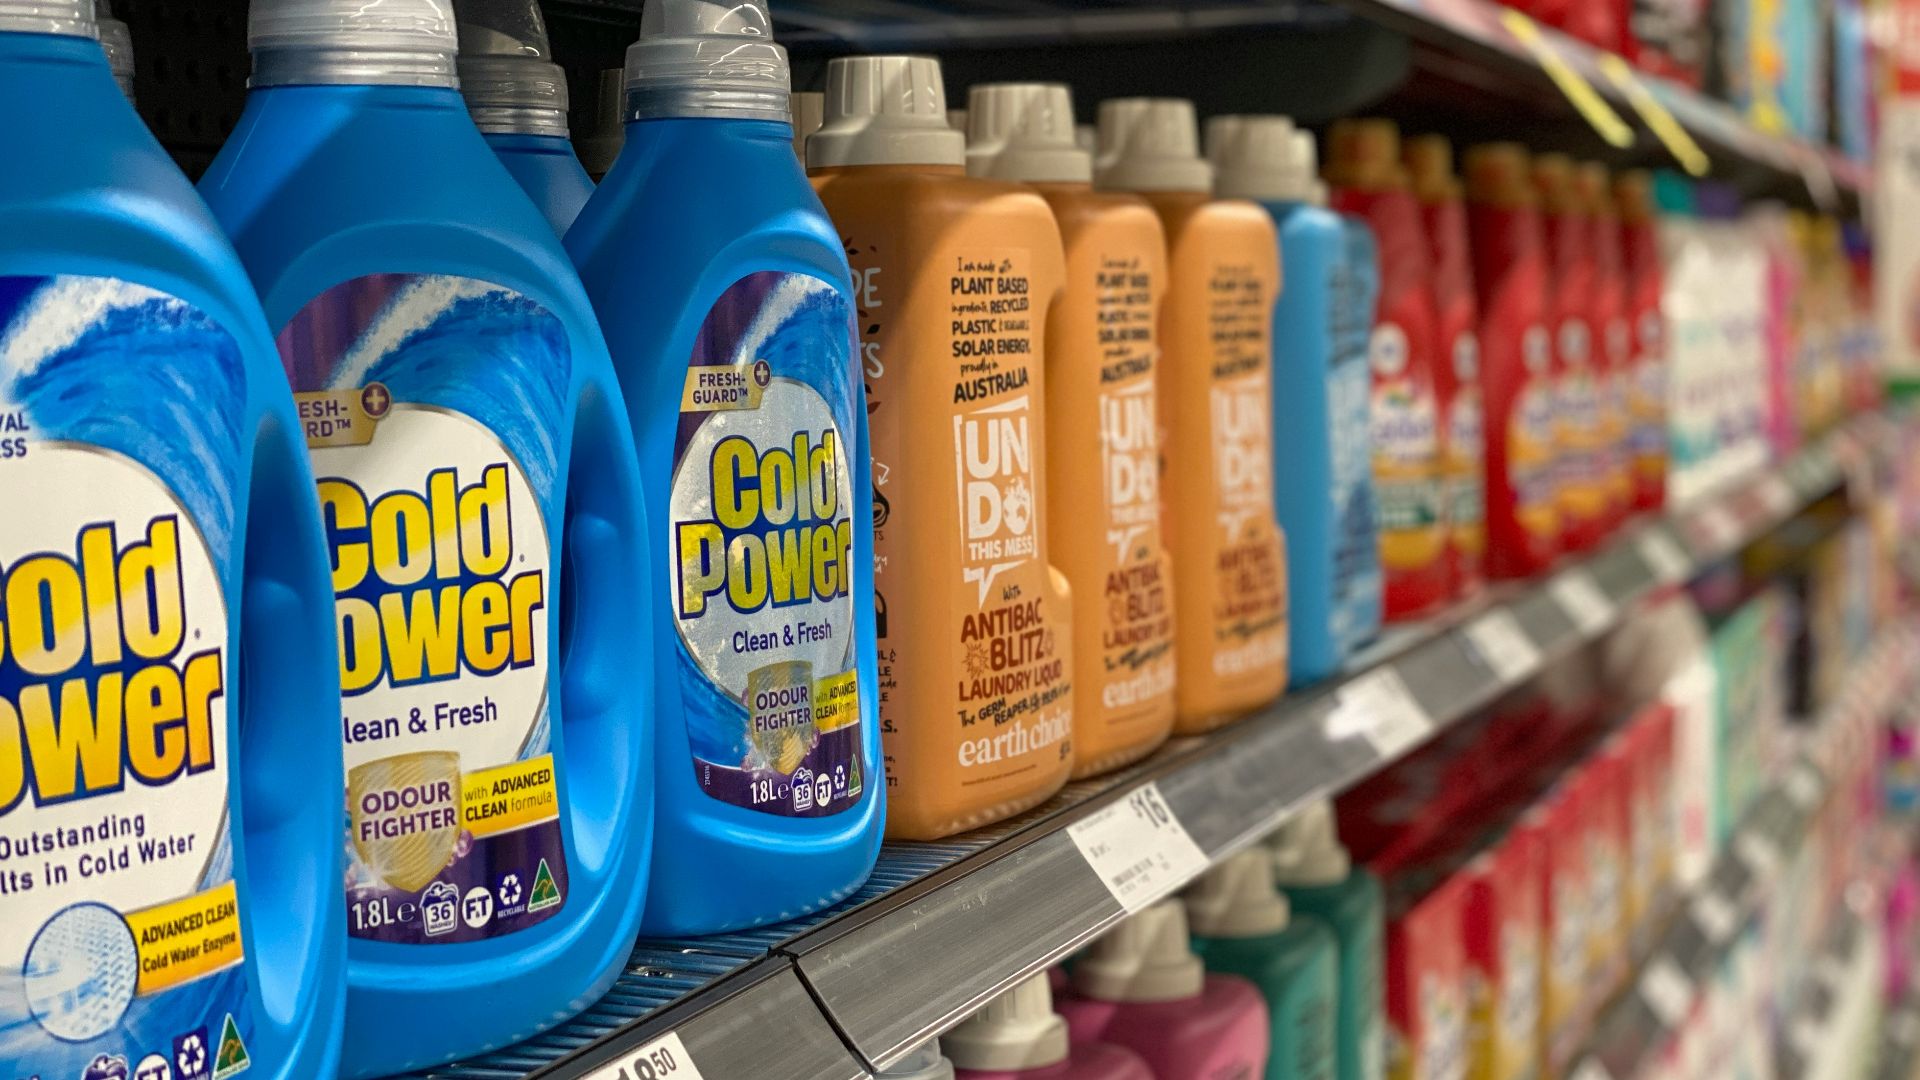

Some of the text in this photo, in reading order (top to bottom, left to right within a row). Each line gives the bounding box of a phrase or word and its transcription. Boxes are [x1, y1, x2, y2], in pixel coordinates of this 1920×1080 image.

[951, 276, 1028, 295] PLANT BASED
[990, 297, 1029, 315] RECYCLED
[952, 319, 996, 336] PLASTIC
[952, 339, 995, 357] SOLAR
[699, 373, 746, 388] FRESH-
[953, 366, 1029, 404] AUSTRALIA
[965, 416, 1029, 480] UN
[709, 428, 837, 531] Cold
[315, 462, 513, 593] Cold
[968, 535, 1033, 561] THIS MESS
[675, 517, 851, 620] Power
[0, 512, 186, 678] old
[732, 618, 832, 654] Clean & Fresh
[960, 597, 1043, 643] ANTIBAC
[990, 626, 1045, 672] BLITZ
[756, 686, 809, 711] ODOUR
[958, 670, 1032, 702] LAUNDRY
[407, 706, 428, 734] &
[434, 696, 498, 731] Fresh
[755, 708, 811, 732] FIGHTER
[815, 703, 838, 720] CLEAN
[957, 709, 976, 728] The
[978, 697, 1007, 721] GERM
[361, 781, 452, 815] ODOUR
[464, 768, 552, 802] with ADVANCED
[750, 778, 777, 804] 1.8L
[796, 785, 810, 801] 36
[465, 790, 553, 822] CLEAN formula
[360, 807, 457, 842] FIGHTER
[44, 862, 68, 887] in
[79, 848, 129, 879] Cold
[137, 833, 196, 864] Water
[141, 899, 236, 946] ADVANCED CLEAN
[351, 898, 395, 930] 1.8L
[429, 903, 451, 923] 36
[142, 931, 236, 973] Cold Water Enzyme
